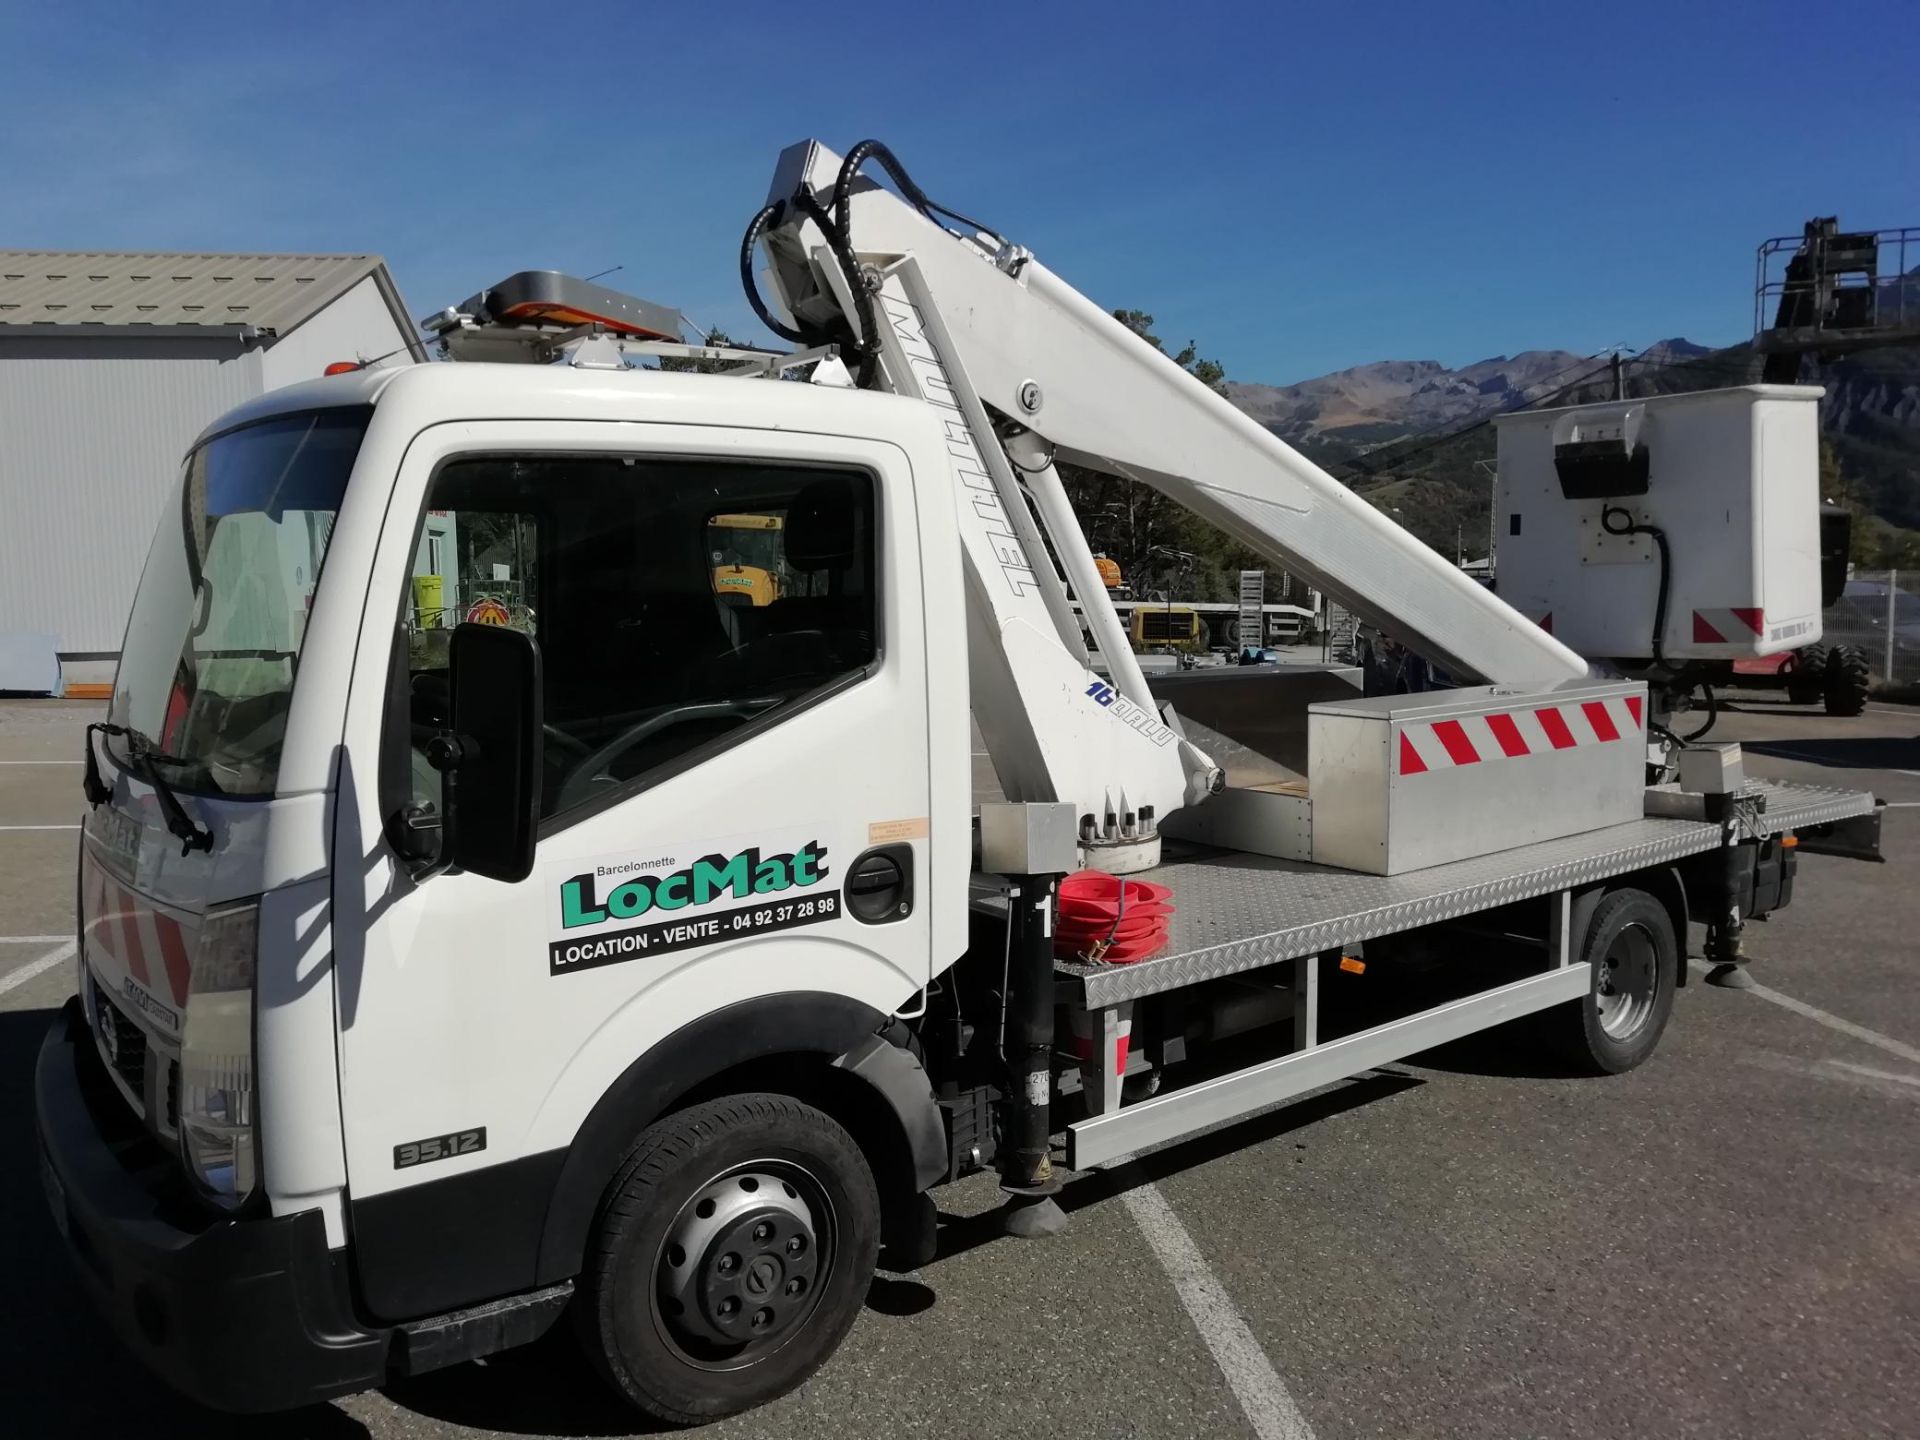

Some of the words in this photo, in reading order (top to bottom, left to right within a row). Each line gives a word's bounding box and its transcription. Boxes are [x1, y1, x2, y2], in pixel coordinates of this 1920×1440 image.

[561, 840, 829, 929] LocMat
[597, 855, 676, 877] Barcelonnette
[554, 933, 648, 966] LOCATION
[663, 920, 719, 944] VENTE
[733, 914, 752, 931] 04
[755, 910, 773, 926] 92
[776, 906, 794, 922] 37
[797, 901, 815, 917] 28
[818, 898, 835, 914] 98
[1035, 895, 1052, 938] 1
[399, 1132, 480, 1166] 35.12
